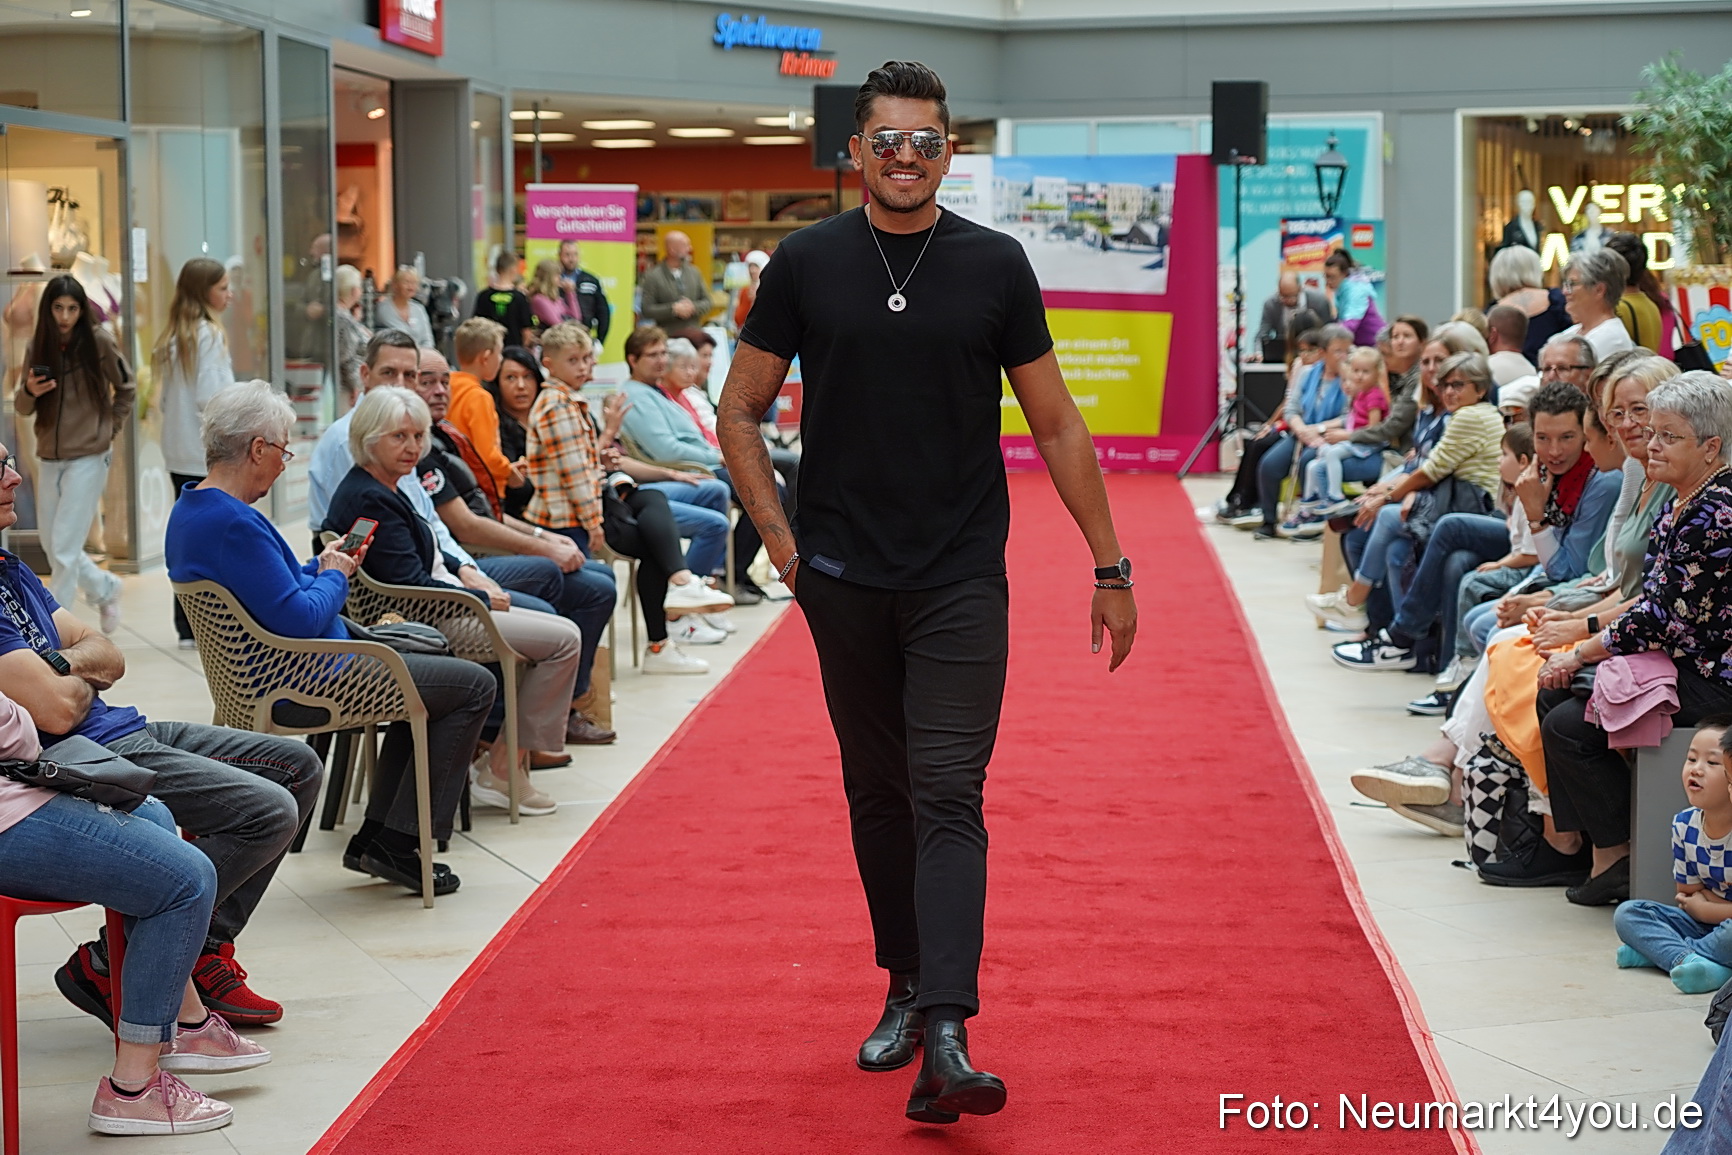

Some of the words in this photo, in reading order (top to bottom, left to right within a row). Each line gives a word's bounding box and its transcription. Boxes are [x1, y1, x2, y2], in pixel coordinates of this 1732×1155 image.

[713, 12, 823, 51] Spielwaren
[532, 204, 606, 219] Verschenken
[607, 204, 627, 219] Sie
[1547, 182, 1711, 225] VER
[556, 218, 627, 233] Gutscheine!
